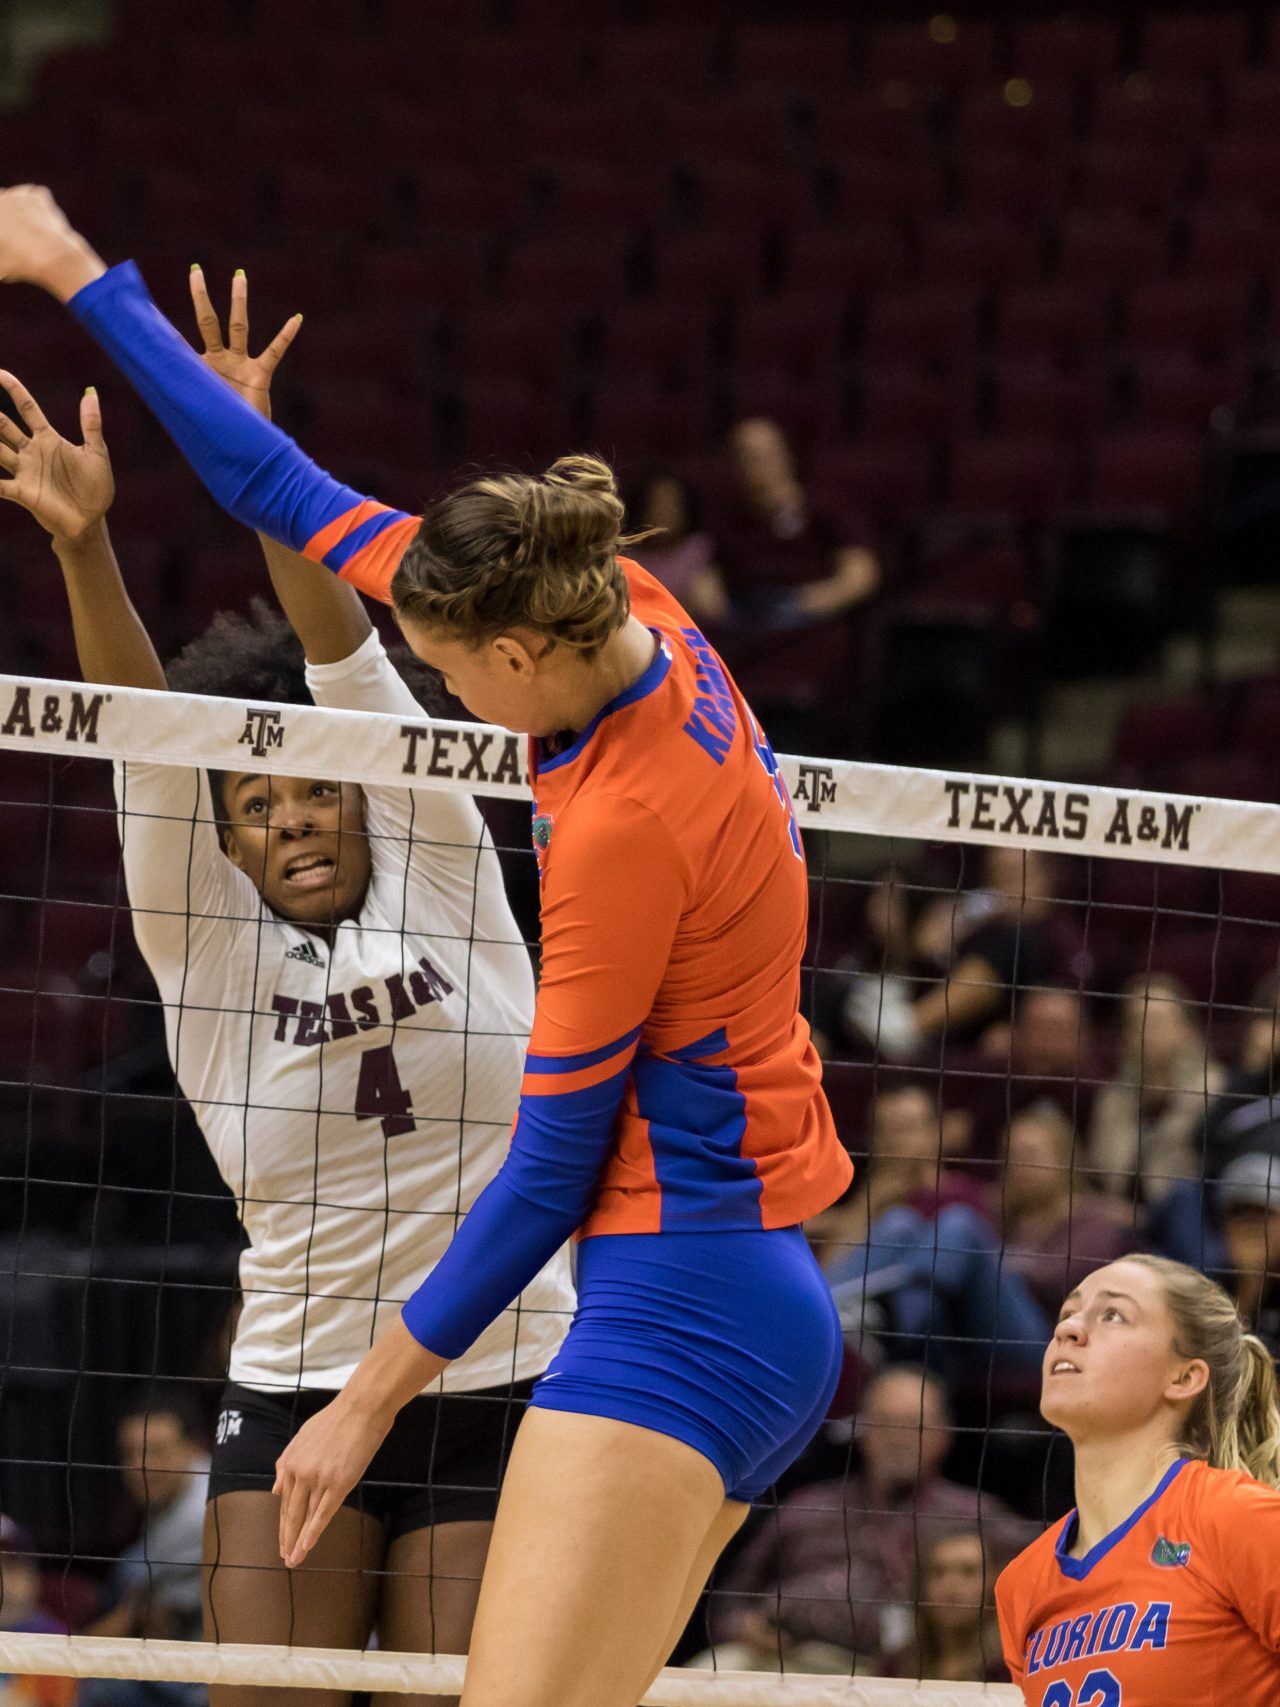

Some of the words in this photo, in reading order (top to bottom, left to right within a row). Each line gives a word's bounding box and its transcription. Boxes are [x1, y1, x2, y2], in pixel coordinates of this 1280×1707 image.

[1, 686, 104, 743] A&M
[400, 725, 530, 786] TEXA
[944, 780, 1090, 840] TEXAS
[1104, 798, 1194, 850] A&M
[355, 1045, 417, 1138] 4
